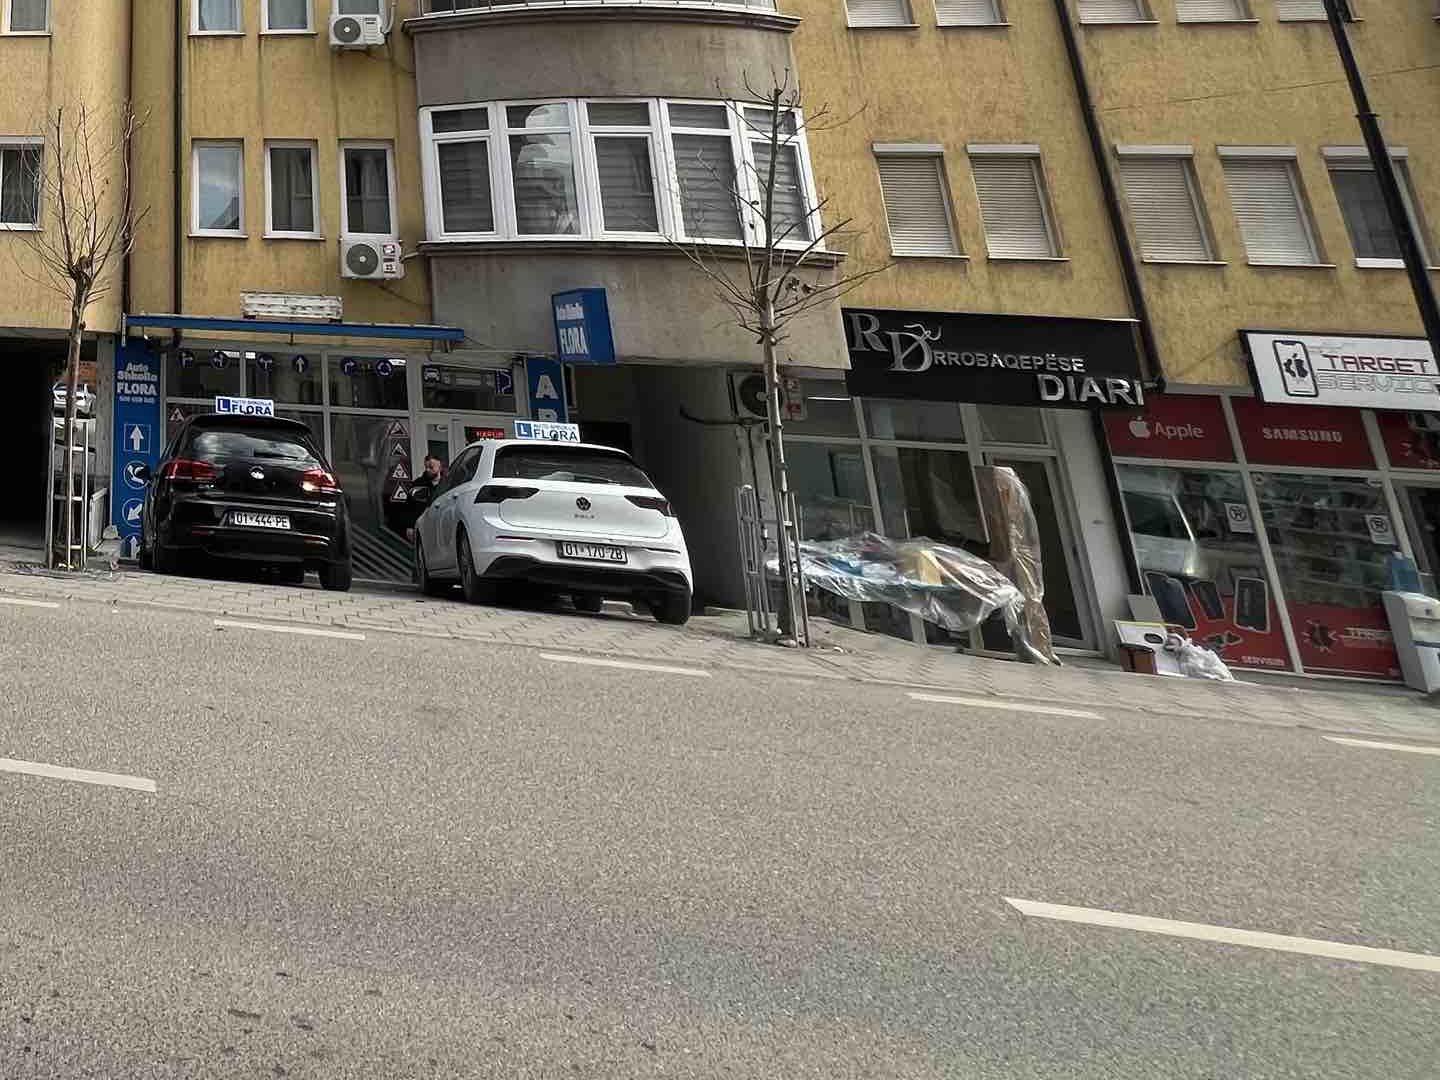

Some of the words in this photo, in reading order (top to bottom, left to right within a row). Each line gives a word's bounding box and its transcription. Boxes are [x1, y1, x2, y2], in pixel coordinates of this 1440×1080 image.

[560, 327, 589, 354] FLORA
[126, 362, 149, 371] Auto
[1322, 353, 1429, 373] TARGET
[117, 382, 158, 396] FLORA
[536, 375, 559, 399] A
[1037, 373, 1145, 406] DIARI
[1316, 373, 1440, 395] SERVIC
[232, 404, 272, 416] FLORA
[533, 429, 578, 441] FLORA
[1154, 423, 1204, 441] Apple
[1262, 427, 1343, 443] SAMSUNG
